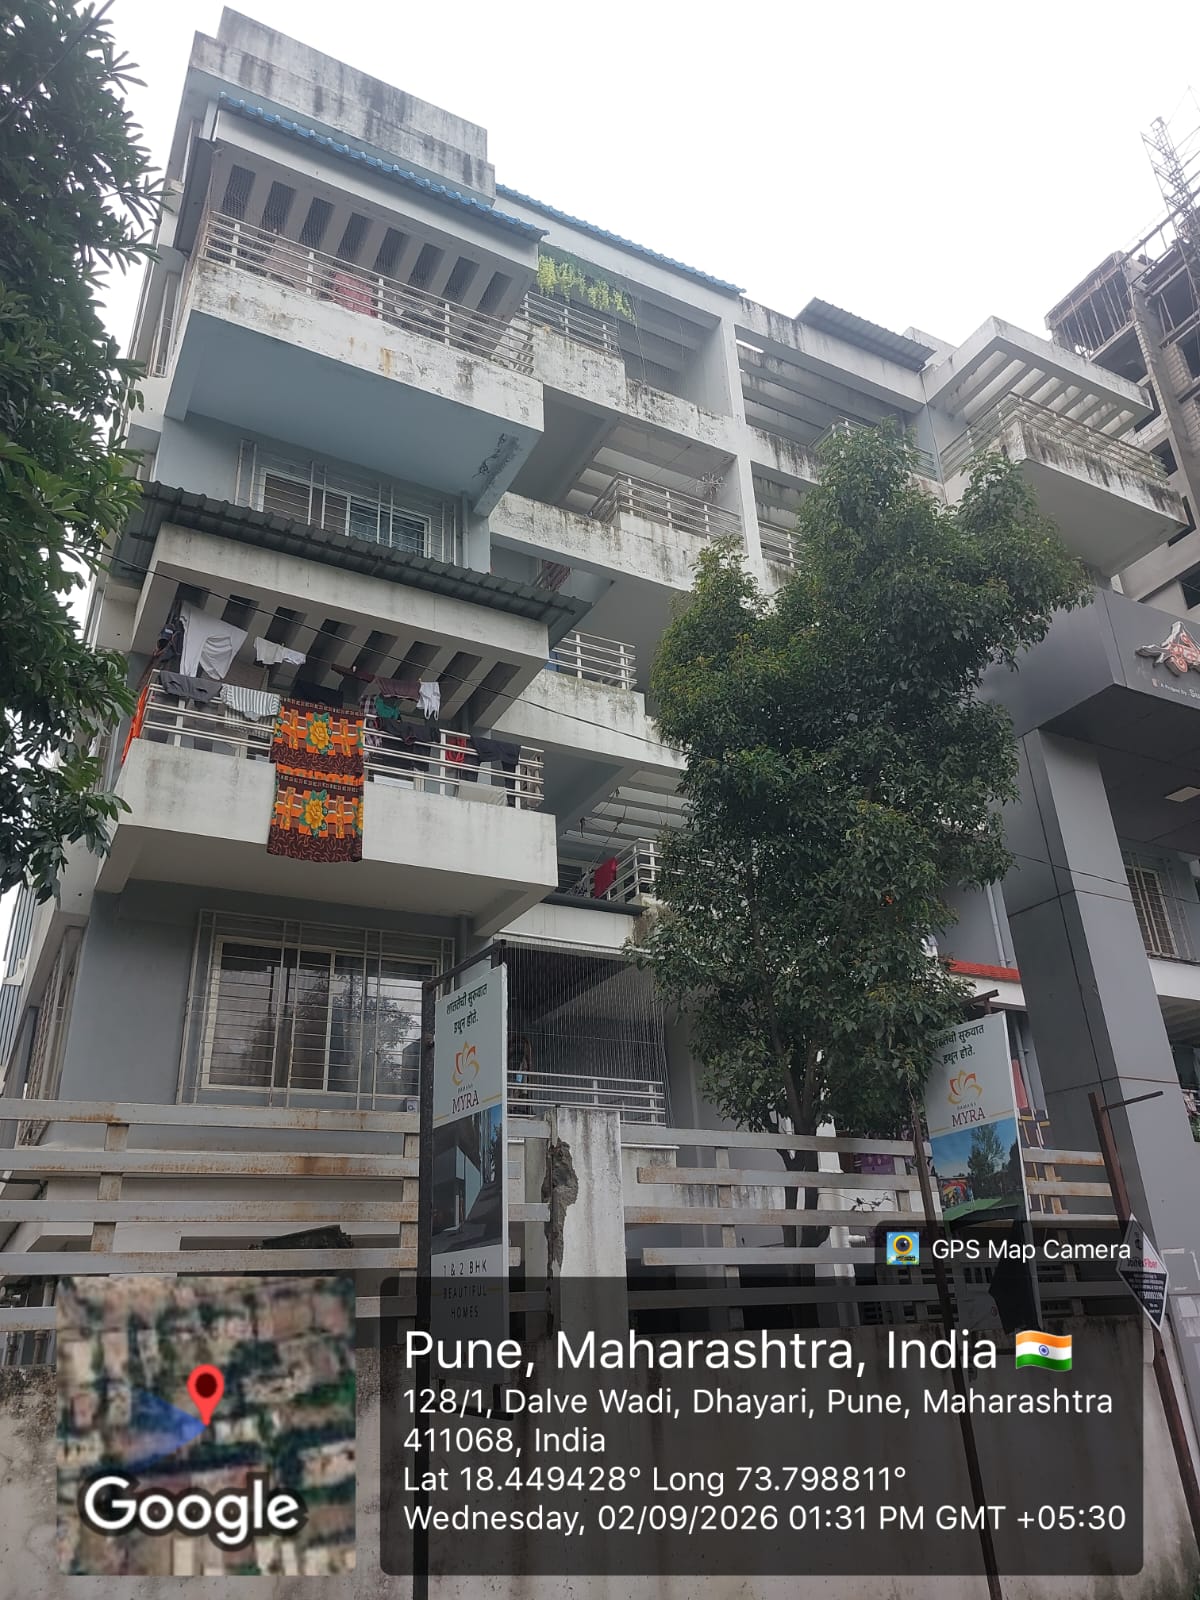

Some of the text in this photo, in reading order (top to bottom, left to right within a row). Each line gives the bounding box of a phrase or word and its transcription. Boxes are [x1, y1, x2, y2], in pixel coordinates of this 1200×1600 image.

[957, 1024, 985, 1044] सुरुवात
[452, 1090, 480, 1115] MYRA
[951, 1106, 986, 1128] MYRA
[451, 1263, 456, 1276] &
[460, 1262, 464, 1275] 2
[469, 1259, 487, 1275] BHK
[443, 1284, 487, 1300] BEAUTIFUL
[450, 1305, 479, 1320] HOMES
